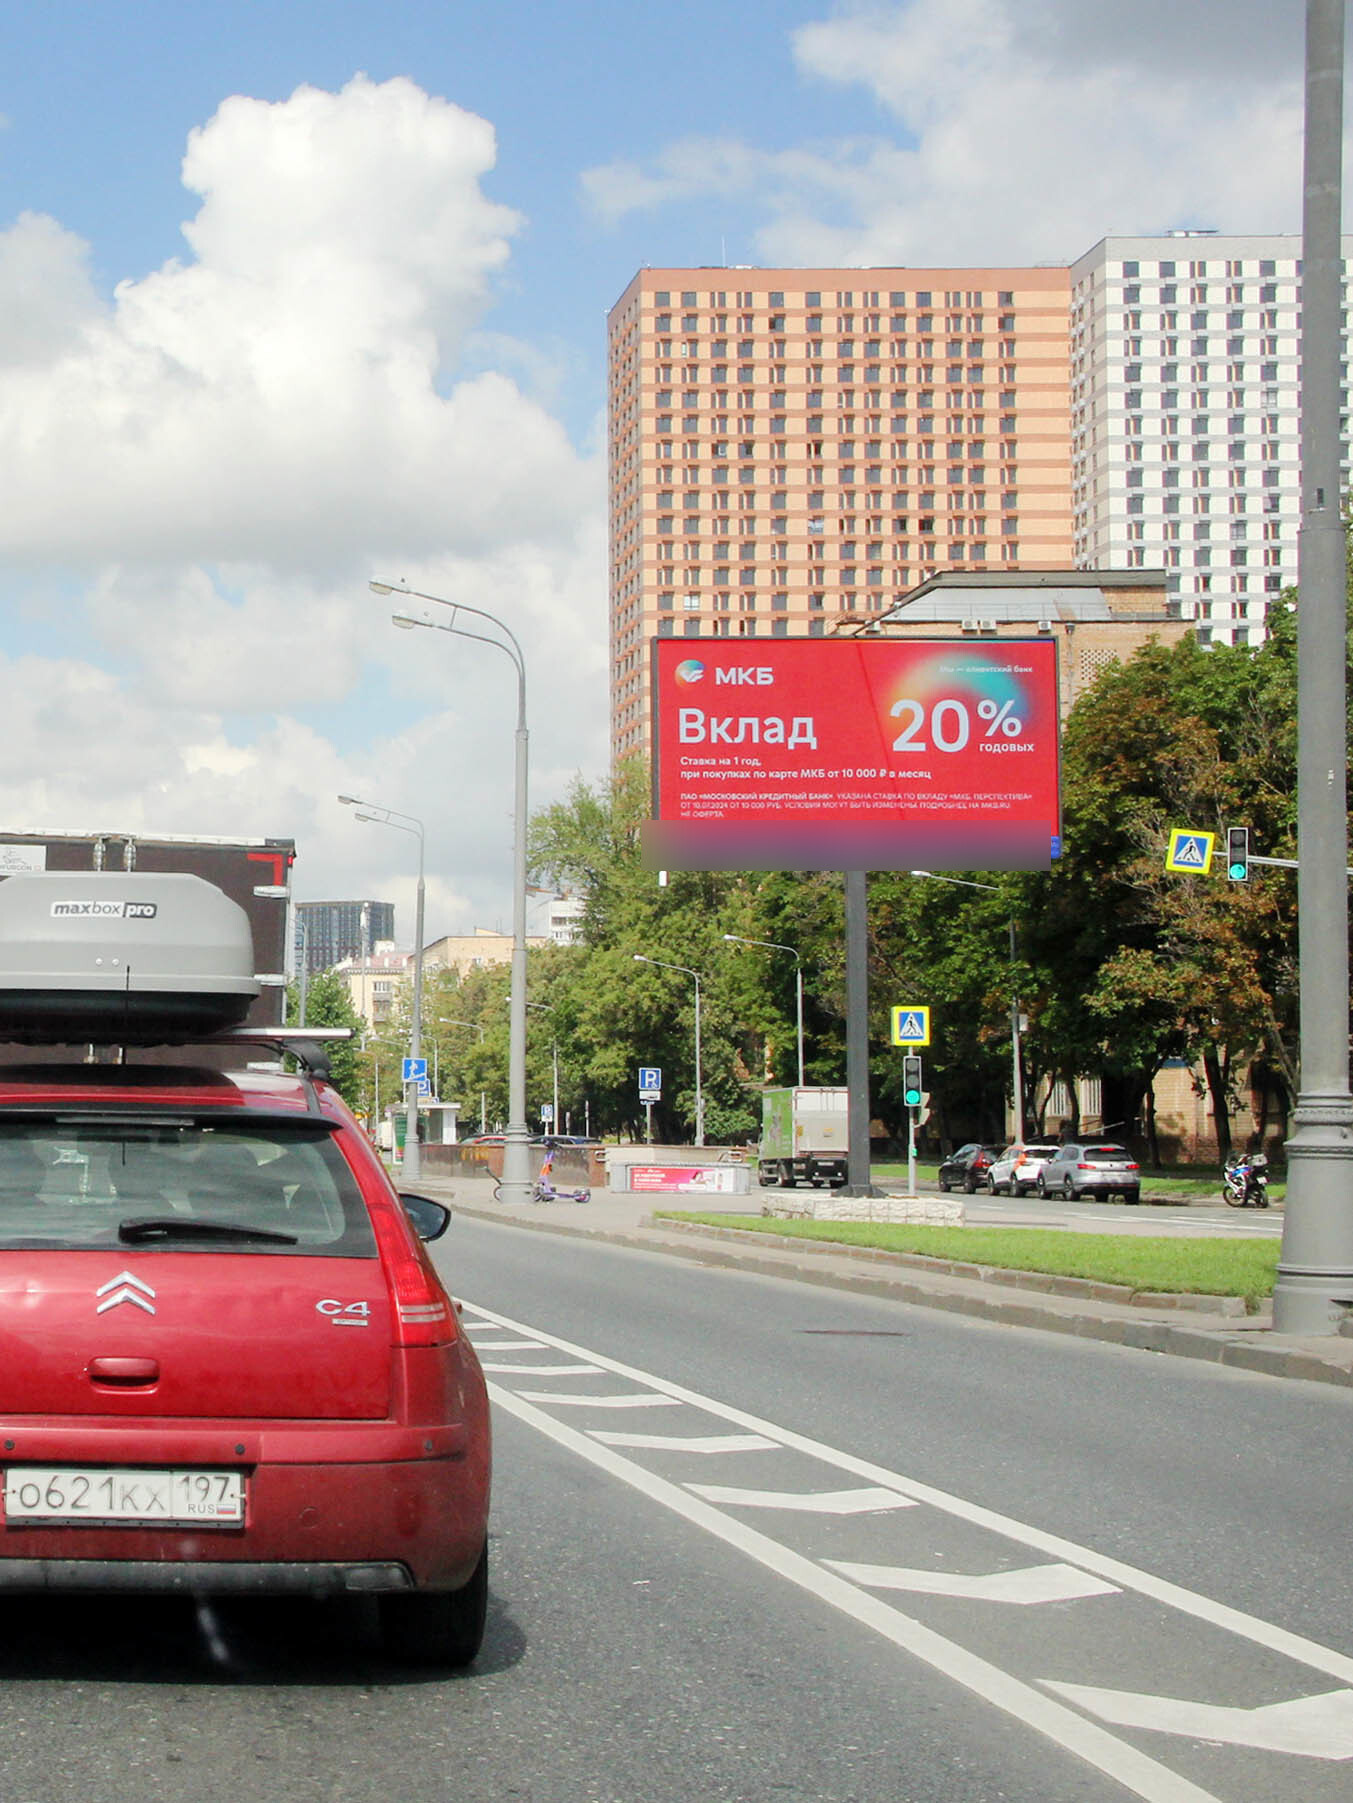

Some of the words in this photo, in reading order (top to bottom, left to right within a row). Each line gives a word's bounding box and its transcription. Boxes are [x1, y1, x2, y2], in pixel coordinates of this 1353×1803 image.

[715, 667, 774, 685] МКБ
[679, 708, 817, 750] Вклад
[890, 699, 1022, 752] 20%
[979, 743, 1034, 753] годовых
[680, 756, 716, 766] Ставка
[733, 757, 739, 766] 1
[680, 770, 700, 780] при
[703, 770, 750, 780] покупках
[753, 770, 767, 779] по
[769, 770, 798, 780] карте
[800, 769, 825, 779] МКБ
[842, 769, 853, 778] 10
[856, 769, 877, 778] 000
[898, 771, 931, 780] месяц
[126, 904, 154, 917] pro
[316, 1299, 371, 1316] C4
[19, 1475, 166, 1511] О621КХ
[179, 1476, 230, 1502] 197
[188, 1503, 215, 1514] RUS
